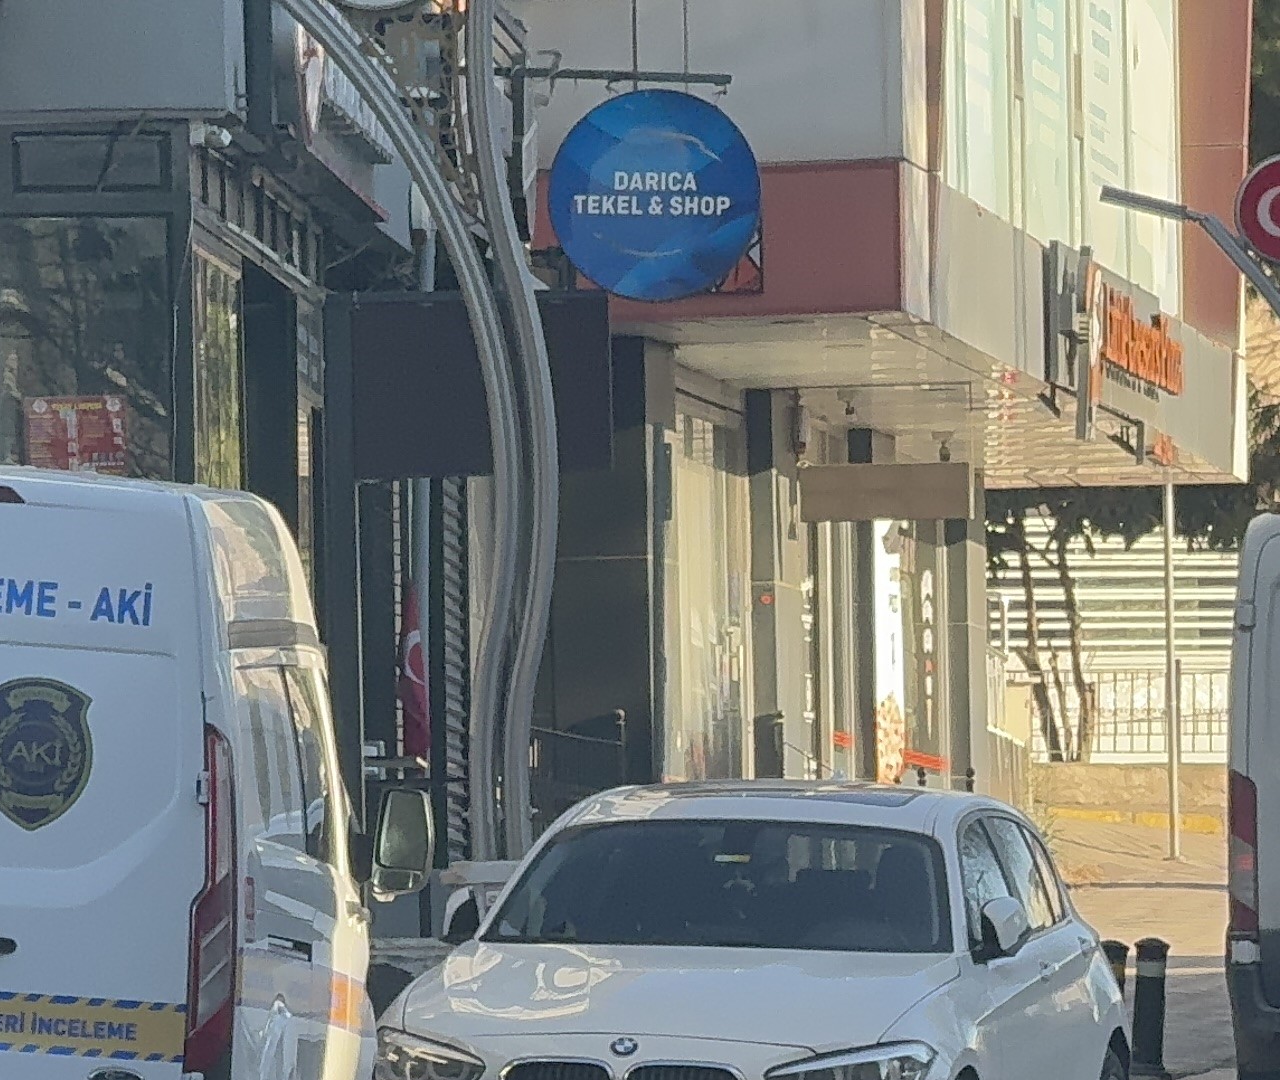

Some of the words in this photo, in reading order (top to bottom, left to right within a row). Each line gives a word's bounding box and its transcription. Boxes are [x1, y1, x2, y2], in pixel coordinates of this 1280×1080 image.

[614, 171, 697, 191] DARICA
[574, 195, 643, 215] TEKEL
[648, 195, 663, 216] &
[670, 196, 731, 216] SHOP
[90, 583, 152, 627] AKİ
[32, 1011, 137, 1041] İNCELEME
